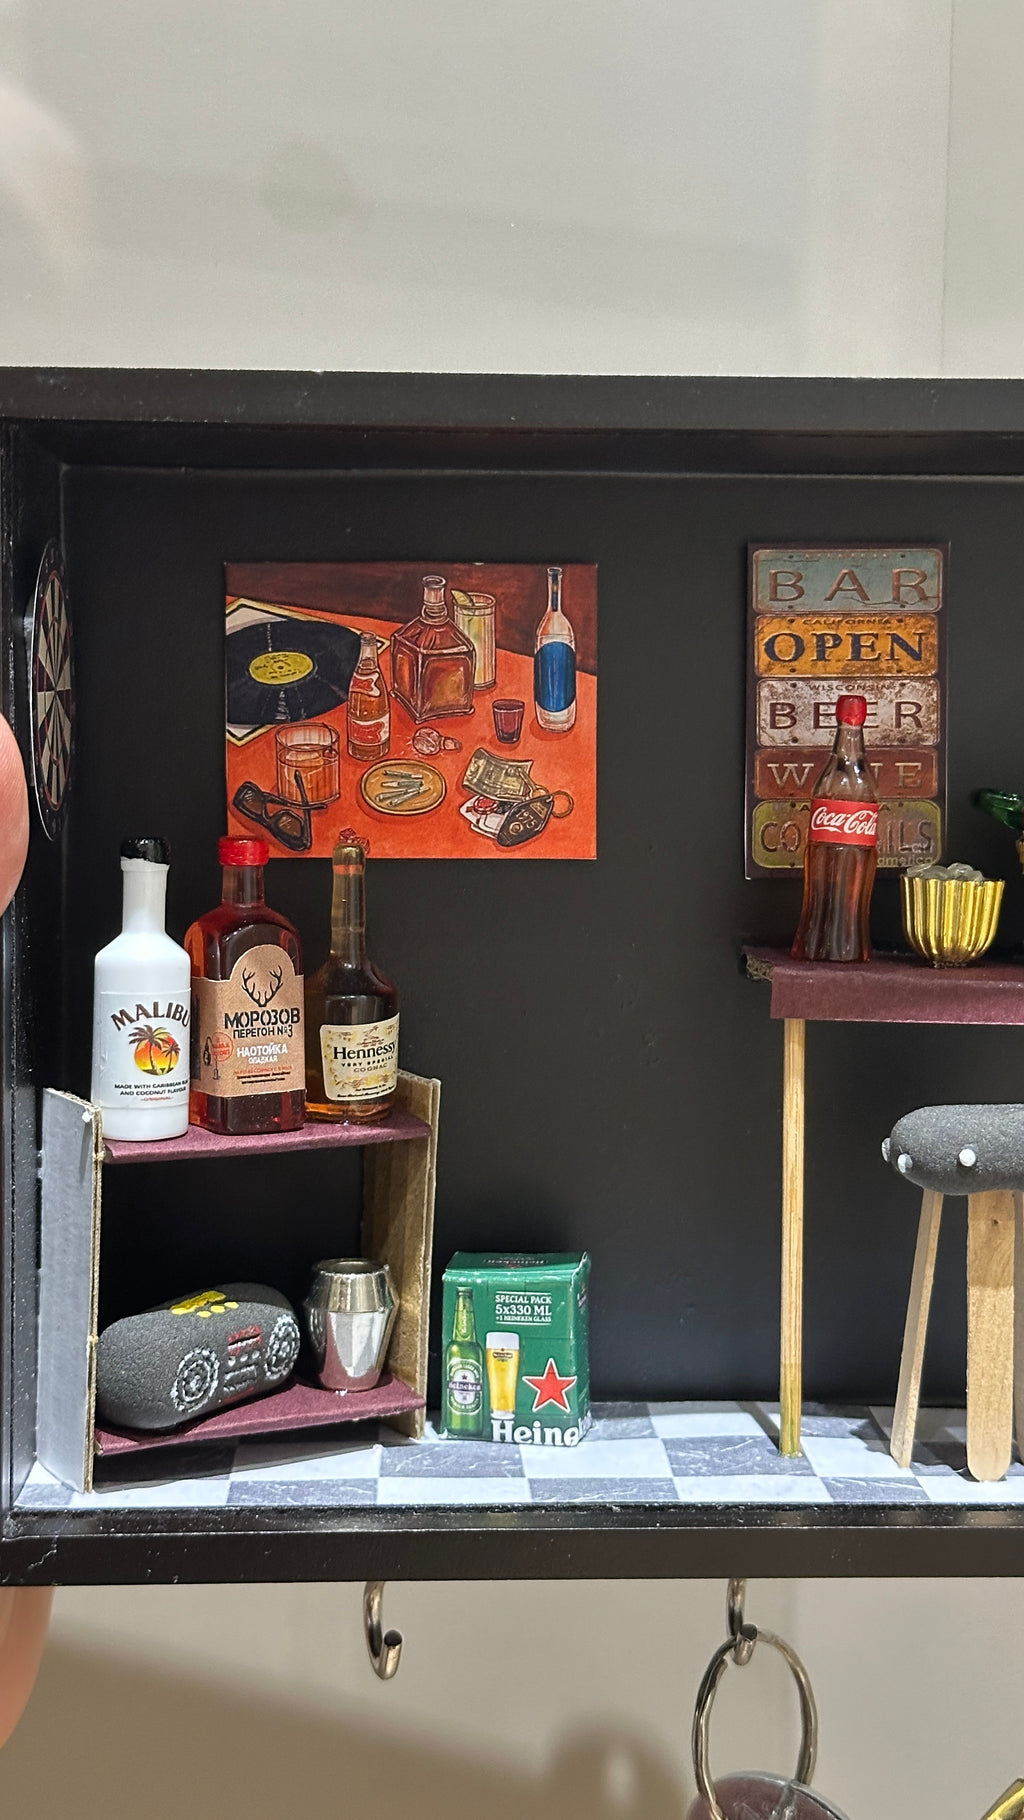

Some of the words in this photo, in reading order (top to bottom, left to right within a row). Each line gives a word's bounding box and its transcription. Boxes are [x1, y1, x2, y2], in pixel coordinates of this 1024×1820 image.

[768, 569, 928, 601] BAR
[801, 617, 891, 625] CALIFORNIA
[763, 630, 924, 662] OPEN
[808, 683, 891, 692] WISCONSIN
[515, 809, 538, 829] 1975
[811, 806, 878, 836] Coca-Cola
[110, 1001, 190, 1031] MALIBU
[224, 1008, 300, 1029] МОРОЗОВ
[233, 1027, 275, 1039] ПЕРЕГОН
[333, 1040, 397, 1060] Hennessy
[353, 1063, 388, 1073] COGNAC
[495, 1294, 529, 1303] SPECIAL
[530, 1296, 552, 1304] PACK
[495, 1304, 531, 1315] 5x330
[533, 1305, 552, 1316] ML
